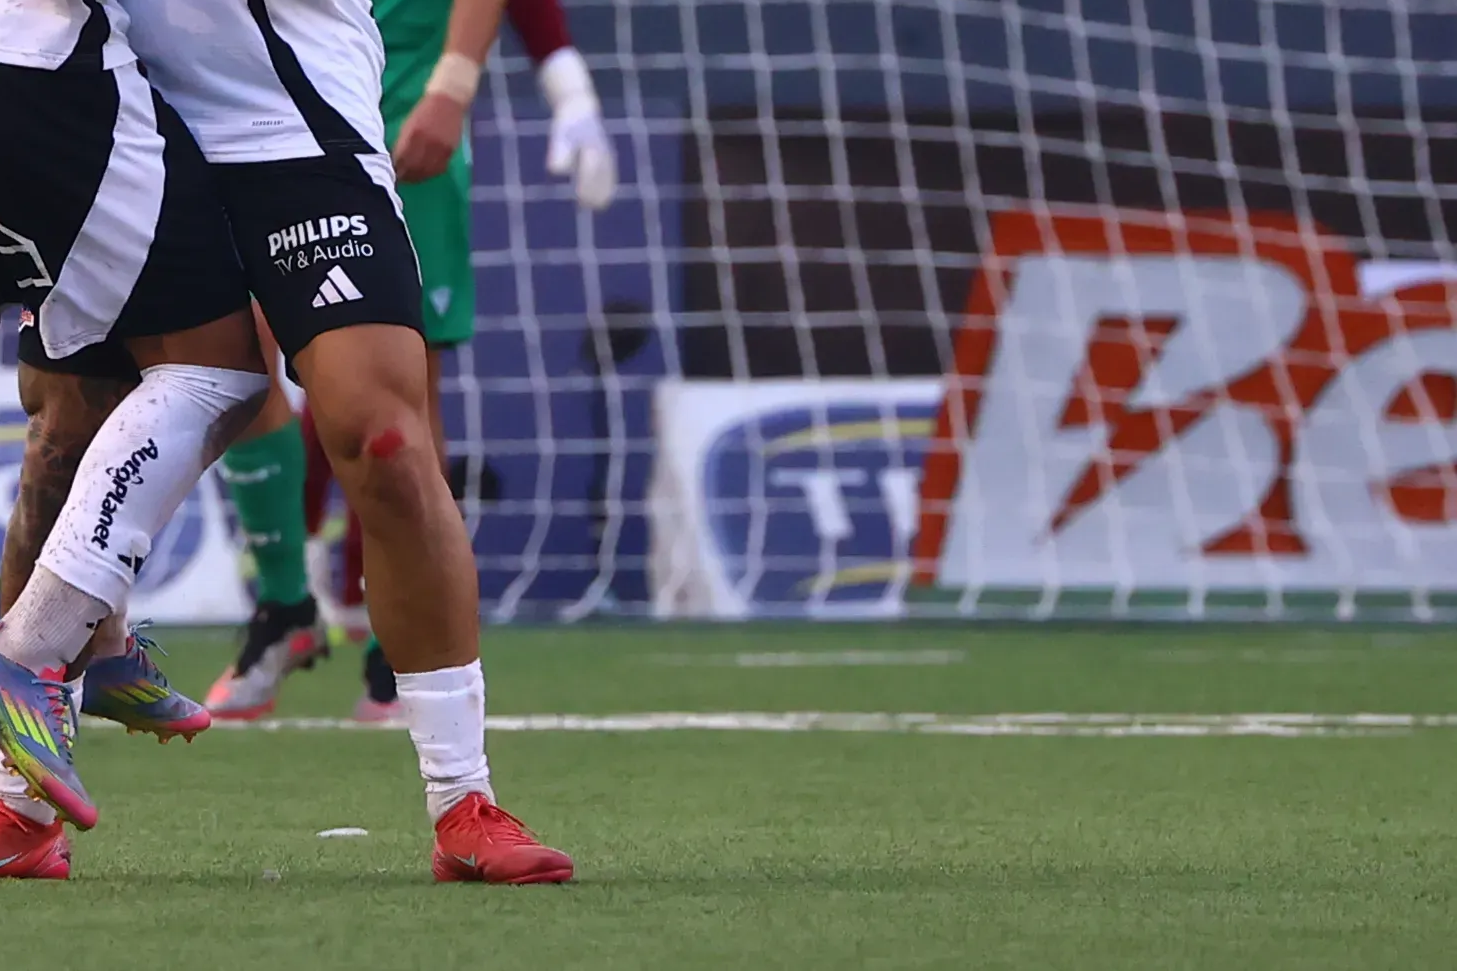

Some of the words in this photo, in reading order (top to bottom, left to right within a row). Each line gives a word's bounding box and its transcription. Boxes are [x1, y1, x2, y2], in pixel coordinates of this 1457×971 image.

[267, 215, 369, 257] PHILIPS
[274, 256, 293, 276] TV
[297, 250, 310, 269] &
[313, 239, 374, 264] Audio
[91, 438, 159, 550] AutoPlanet
